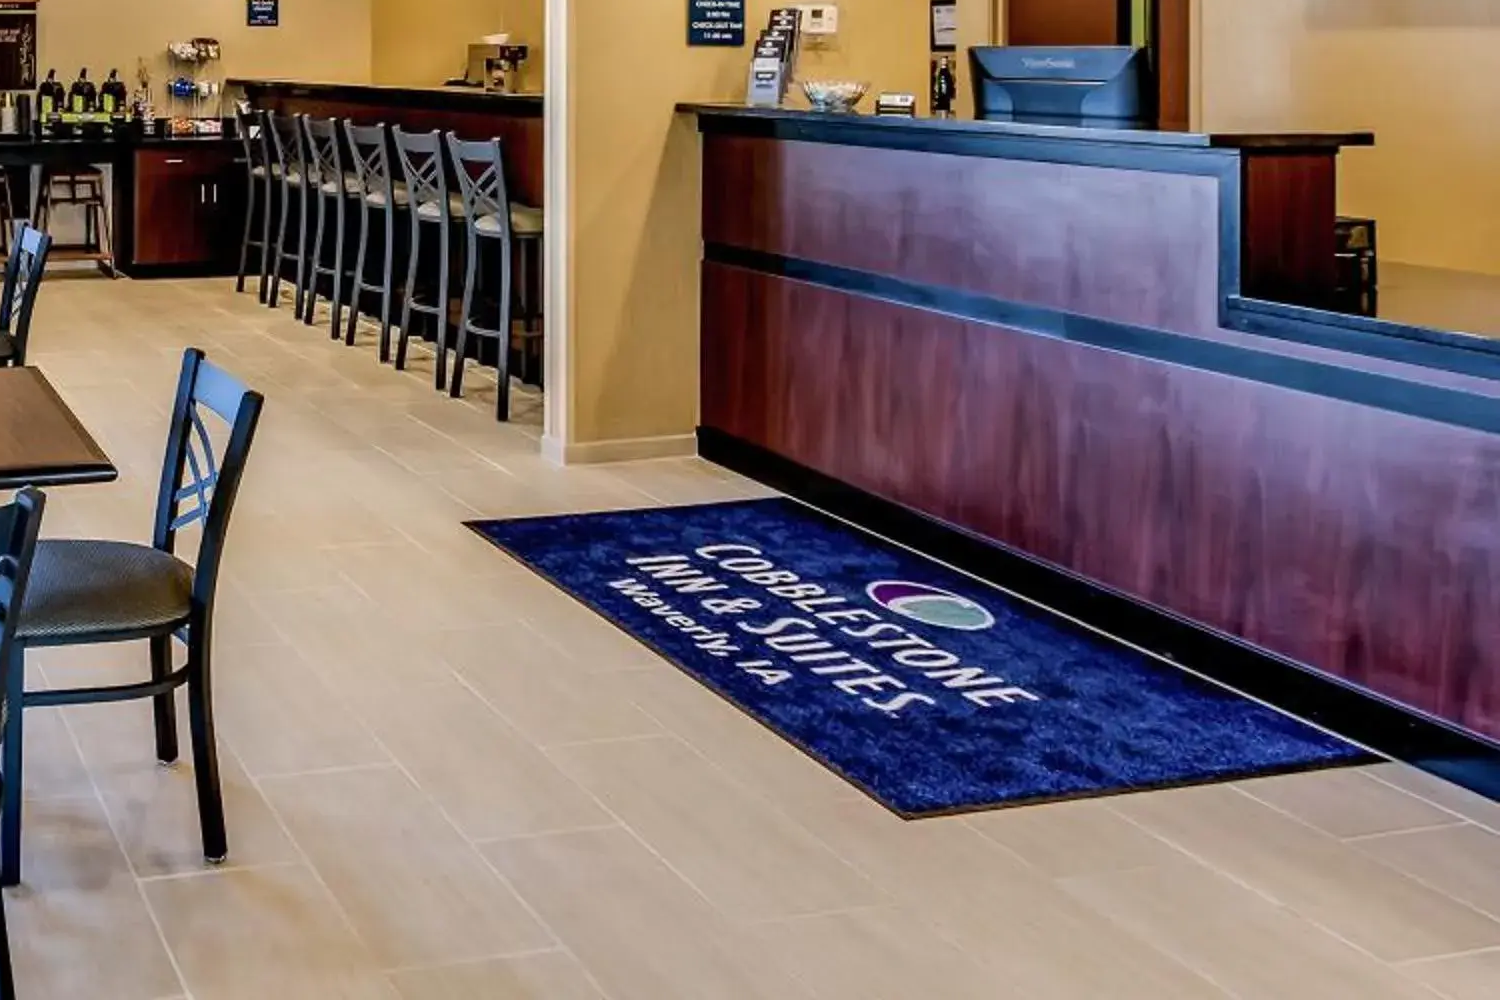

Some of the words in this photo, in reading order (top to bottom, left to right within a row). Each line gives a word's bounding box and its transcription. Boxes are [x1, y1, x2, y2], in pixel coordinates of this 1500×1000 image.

[606, 578, 741, 657] Waverly,
[735, 659, 794, 686] IA
[625, 555, 730, 593] INN
[700, 597, 763, 614] &
[736, 617, 936, 712] SUITES
[695, 544, 1040, 707] COBBLESTONE
